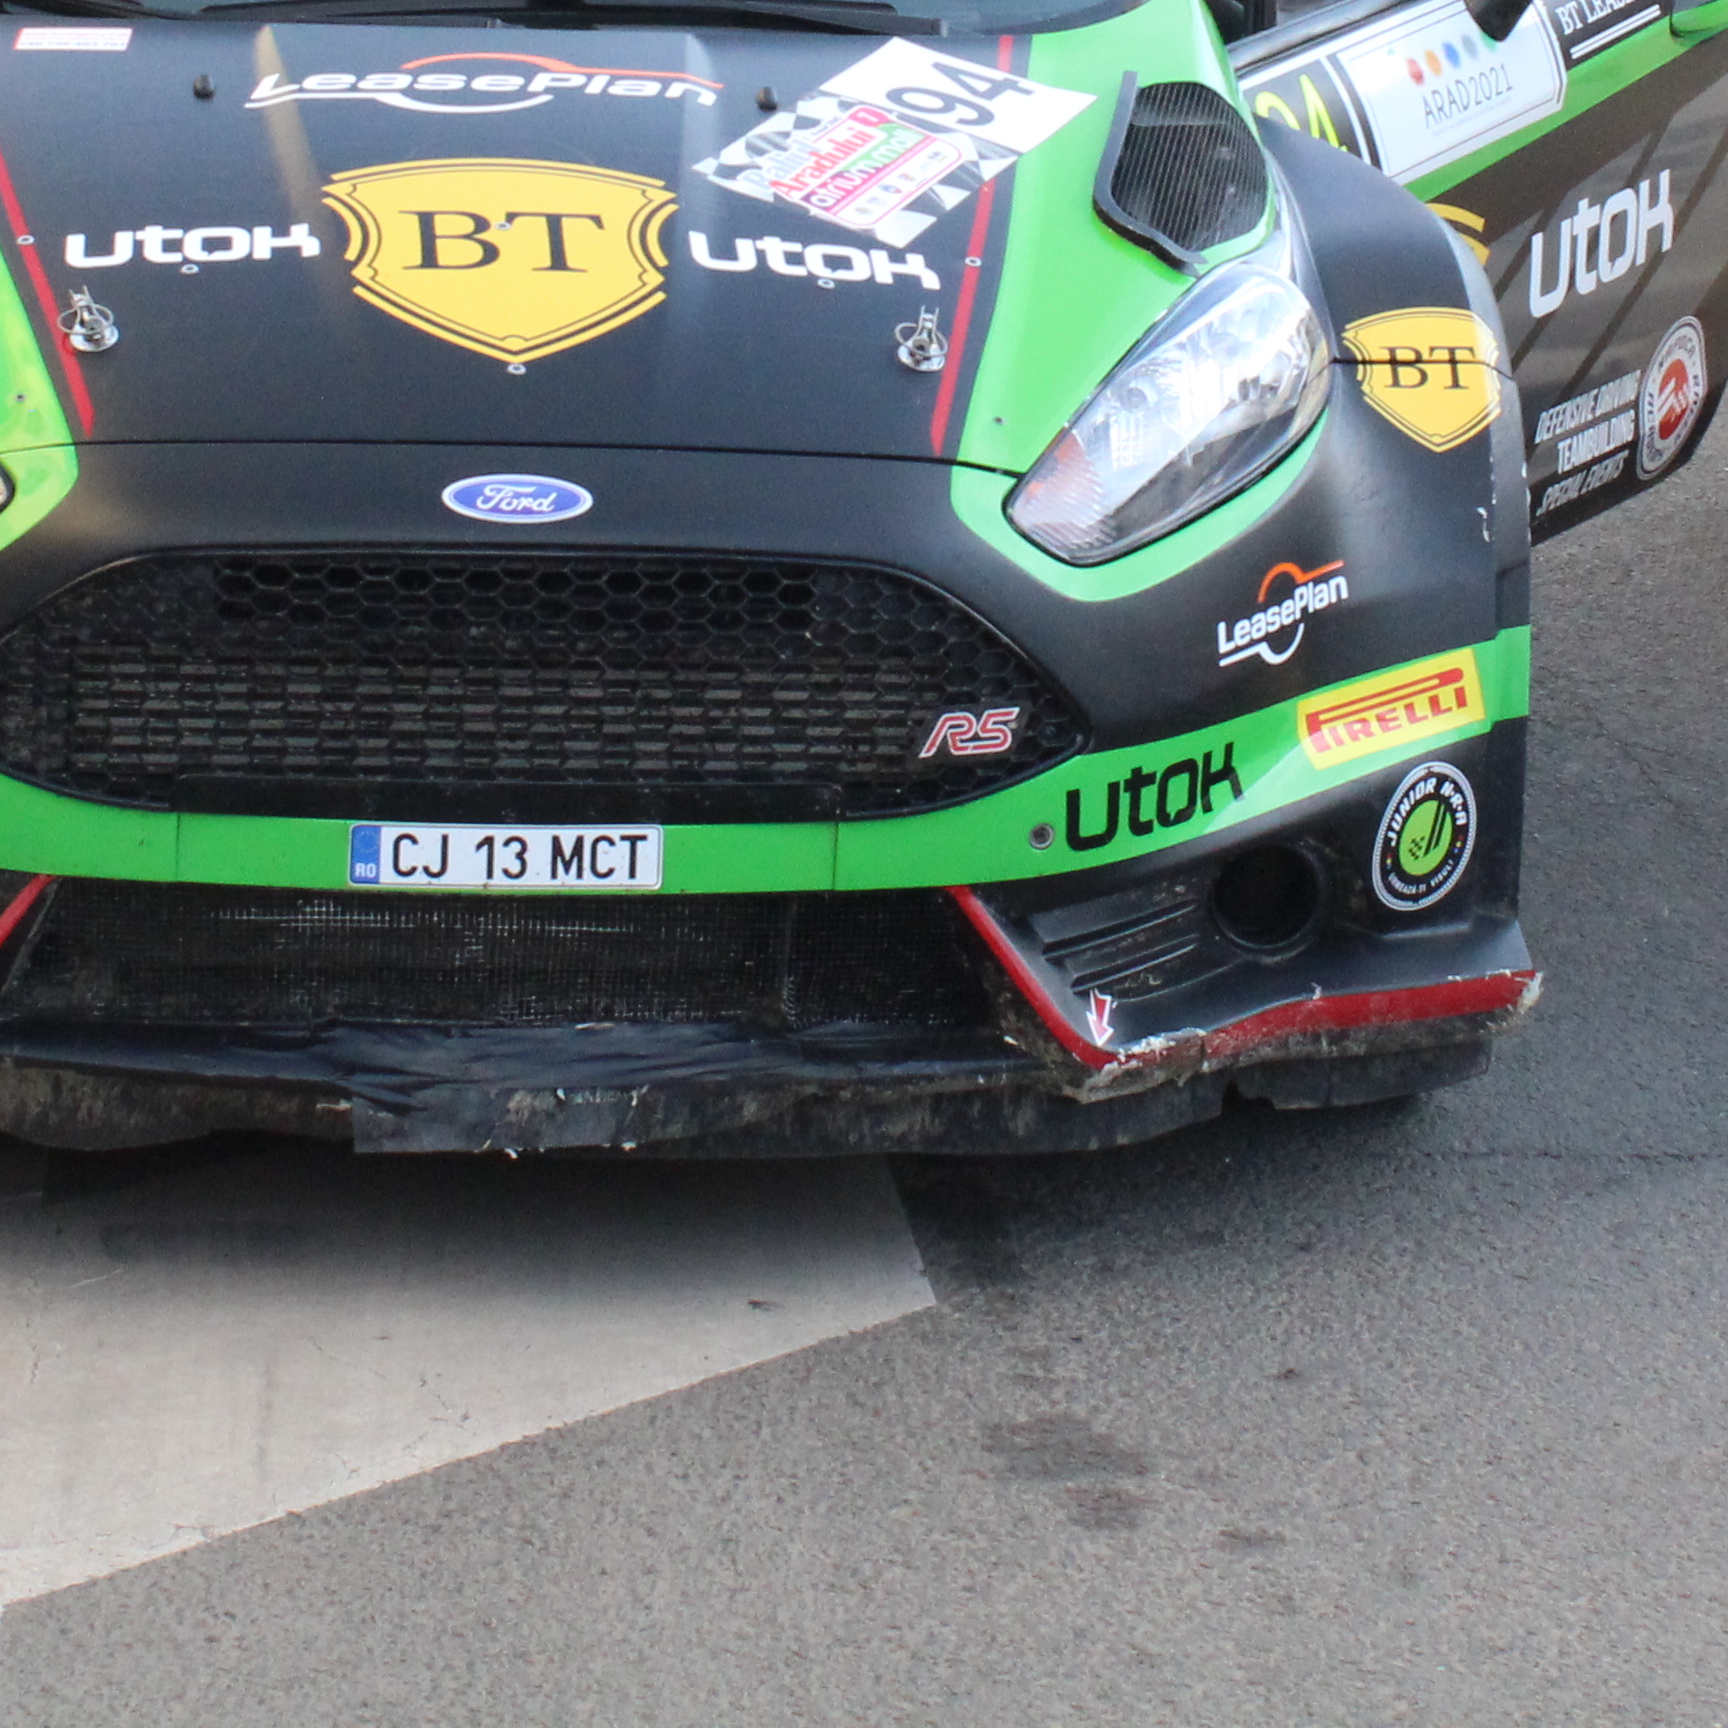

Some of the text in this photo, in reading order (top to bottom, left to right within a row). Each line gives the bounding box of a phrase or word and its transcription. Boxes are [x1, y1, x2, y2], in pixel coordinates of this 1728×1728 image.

[1554, 1, 1582, 36] BT
[252, 70, 718, 106] LeasePlan
[885, 60, 1035, 127] 94
[1422, 65, 1514, 130] ARAD2021
[769, 126, 875, 200] Aradului
[808, 161, 876, 210] atrium
[398, 208, 605, 273] BT
[1380, 343, 1475, 392] BT
[475, 484, 556, 514] Ford
[1217, 573, 1349, 656] LeasePlan
[919, 705, 1021, 759] RS
[1306, 666, 1469, 757] PIRELLI
[1386, 776, 1439, 848] JUNIOR
[354, 862, 377, 879] RO
[392, 832, 649, 881] CJ 13 MCT
